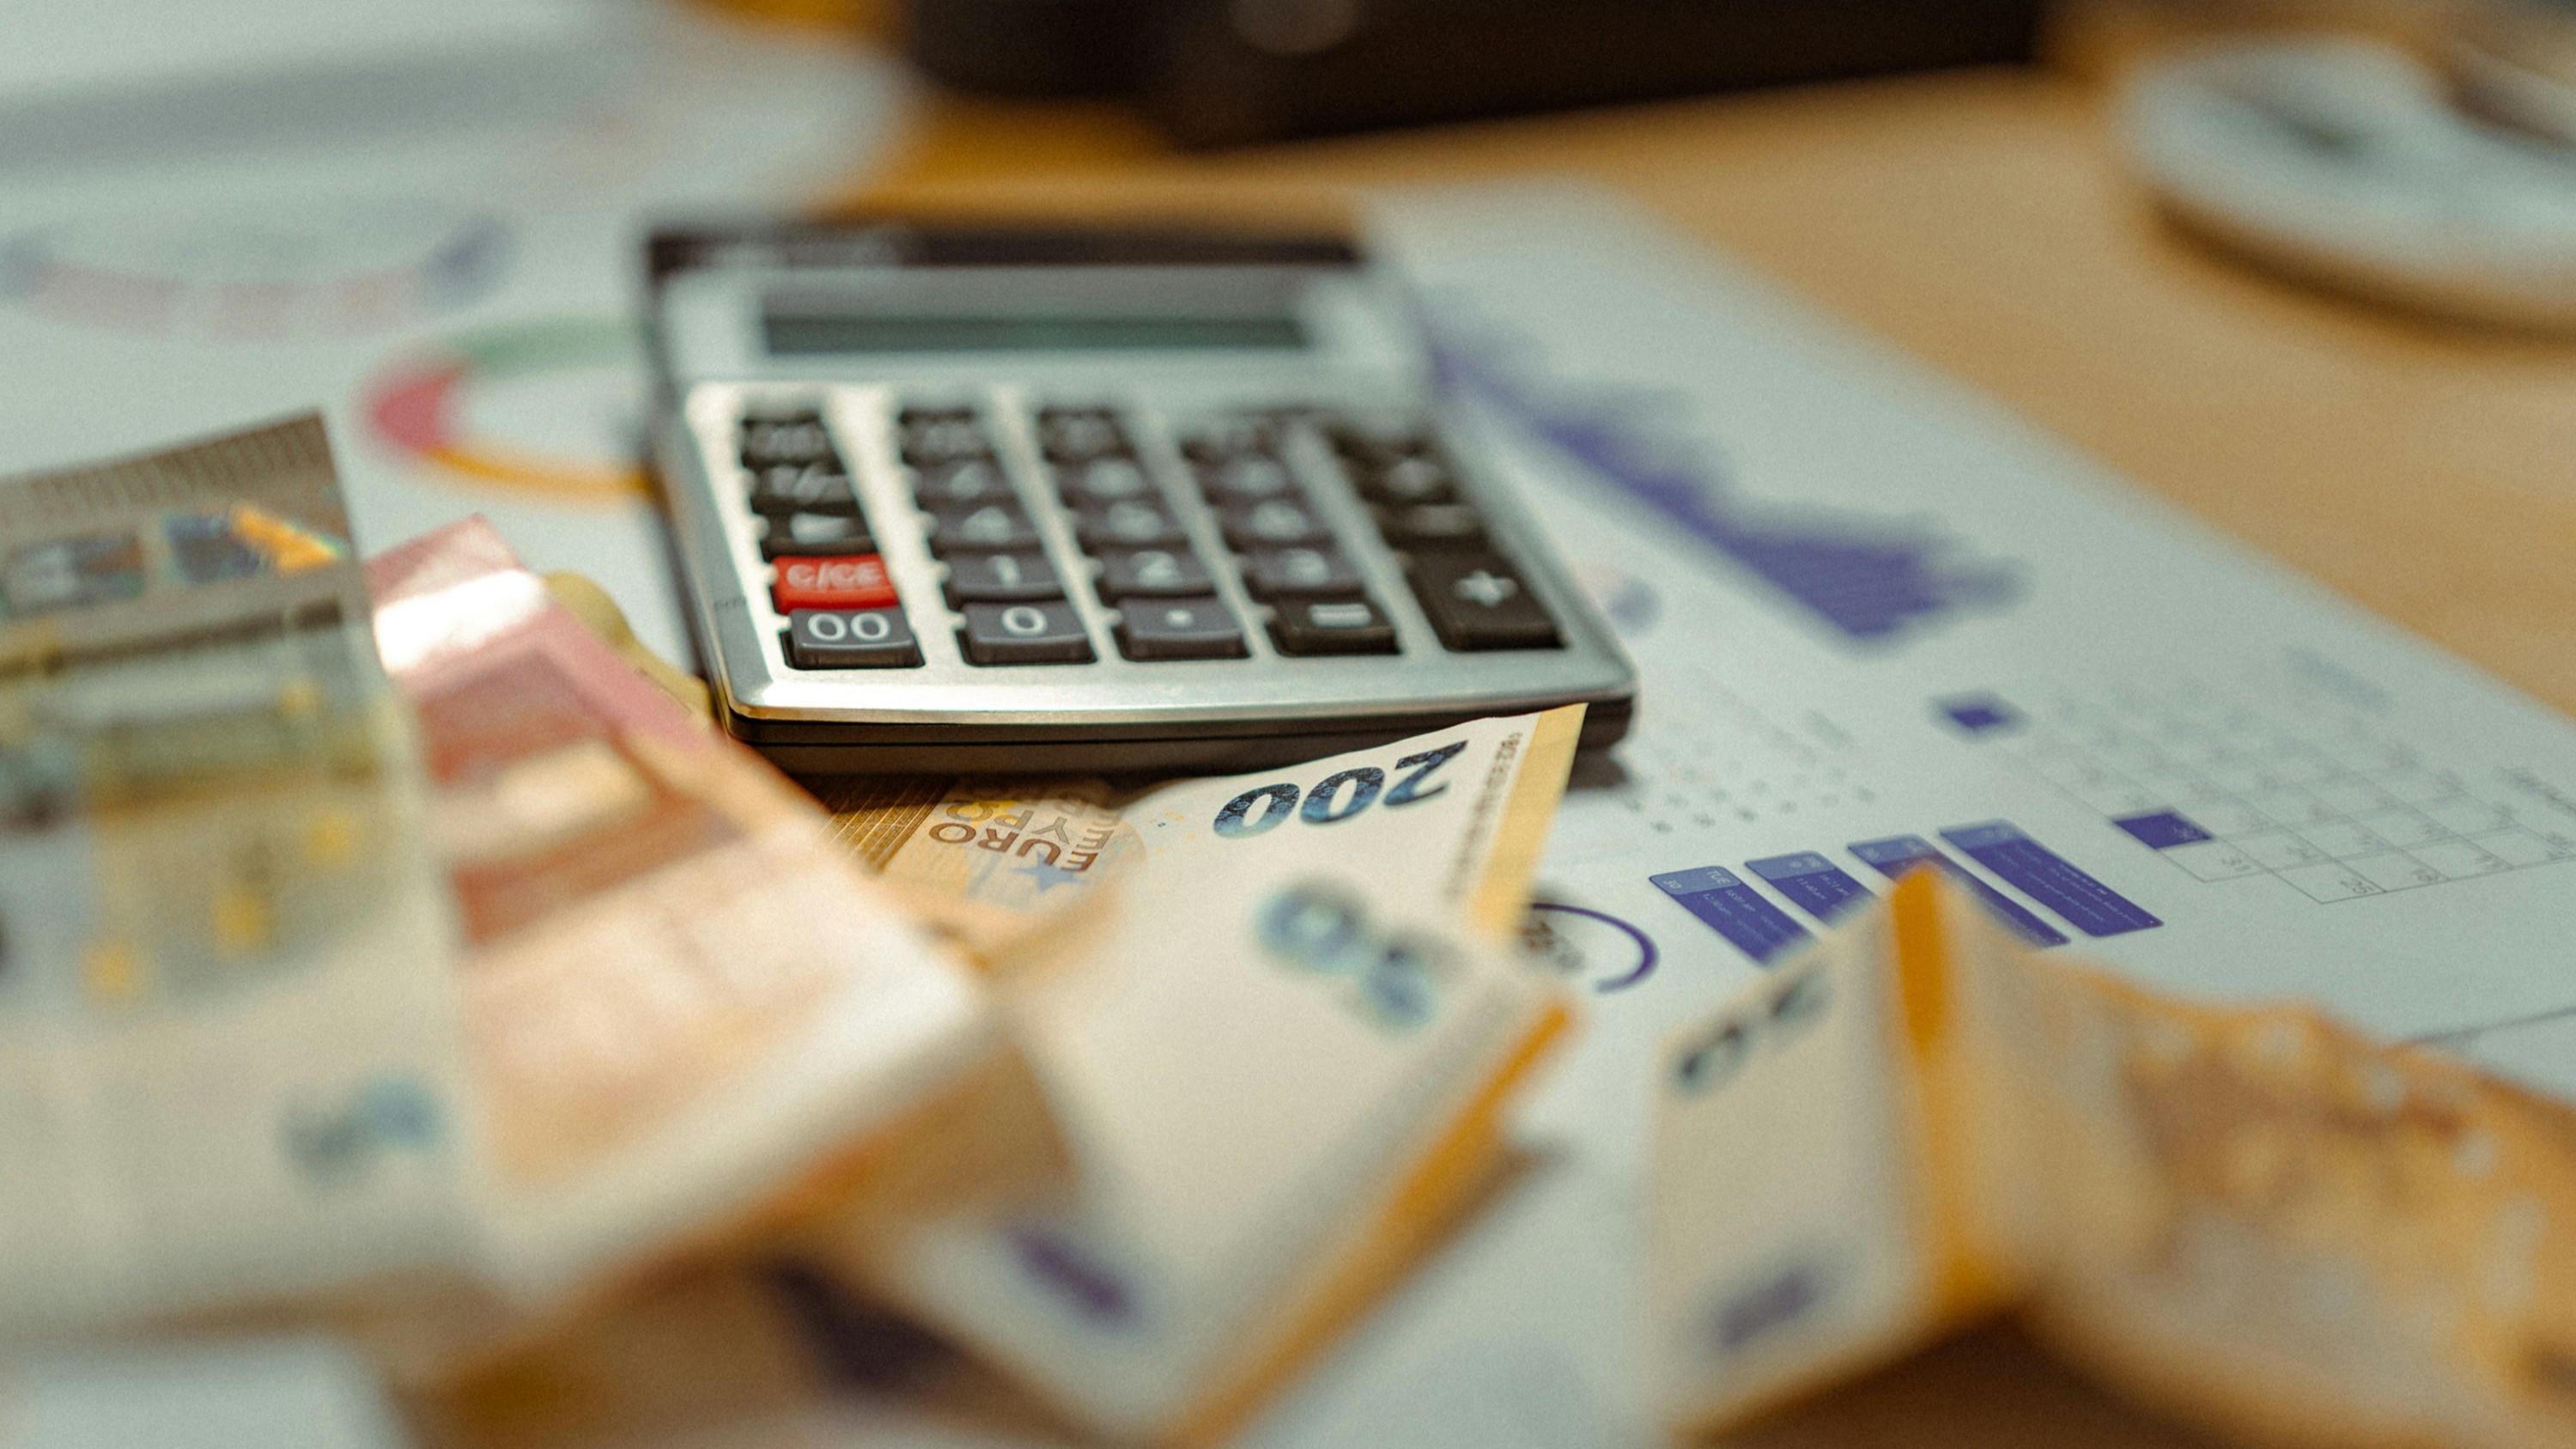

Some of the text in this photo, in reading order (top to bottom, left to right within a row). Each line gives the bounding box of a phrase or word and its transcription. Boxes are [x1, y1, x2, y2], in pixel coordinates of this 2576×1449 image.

[787, 562, 885, 590] C/CE
[807, 612, 890, 641] 00
[1001, 606, 1048, 636] 0
[1212, 739, 1469, 838] 200
[928, 822, 1099, 874] EURO
[1706, 869, 1730, 886] TUE
